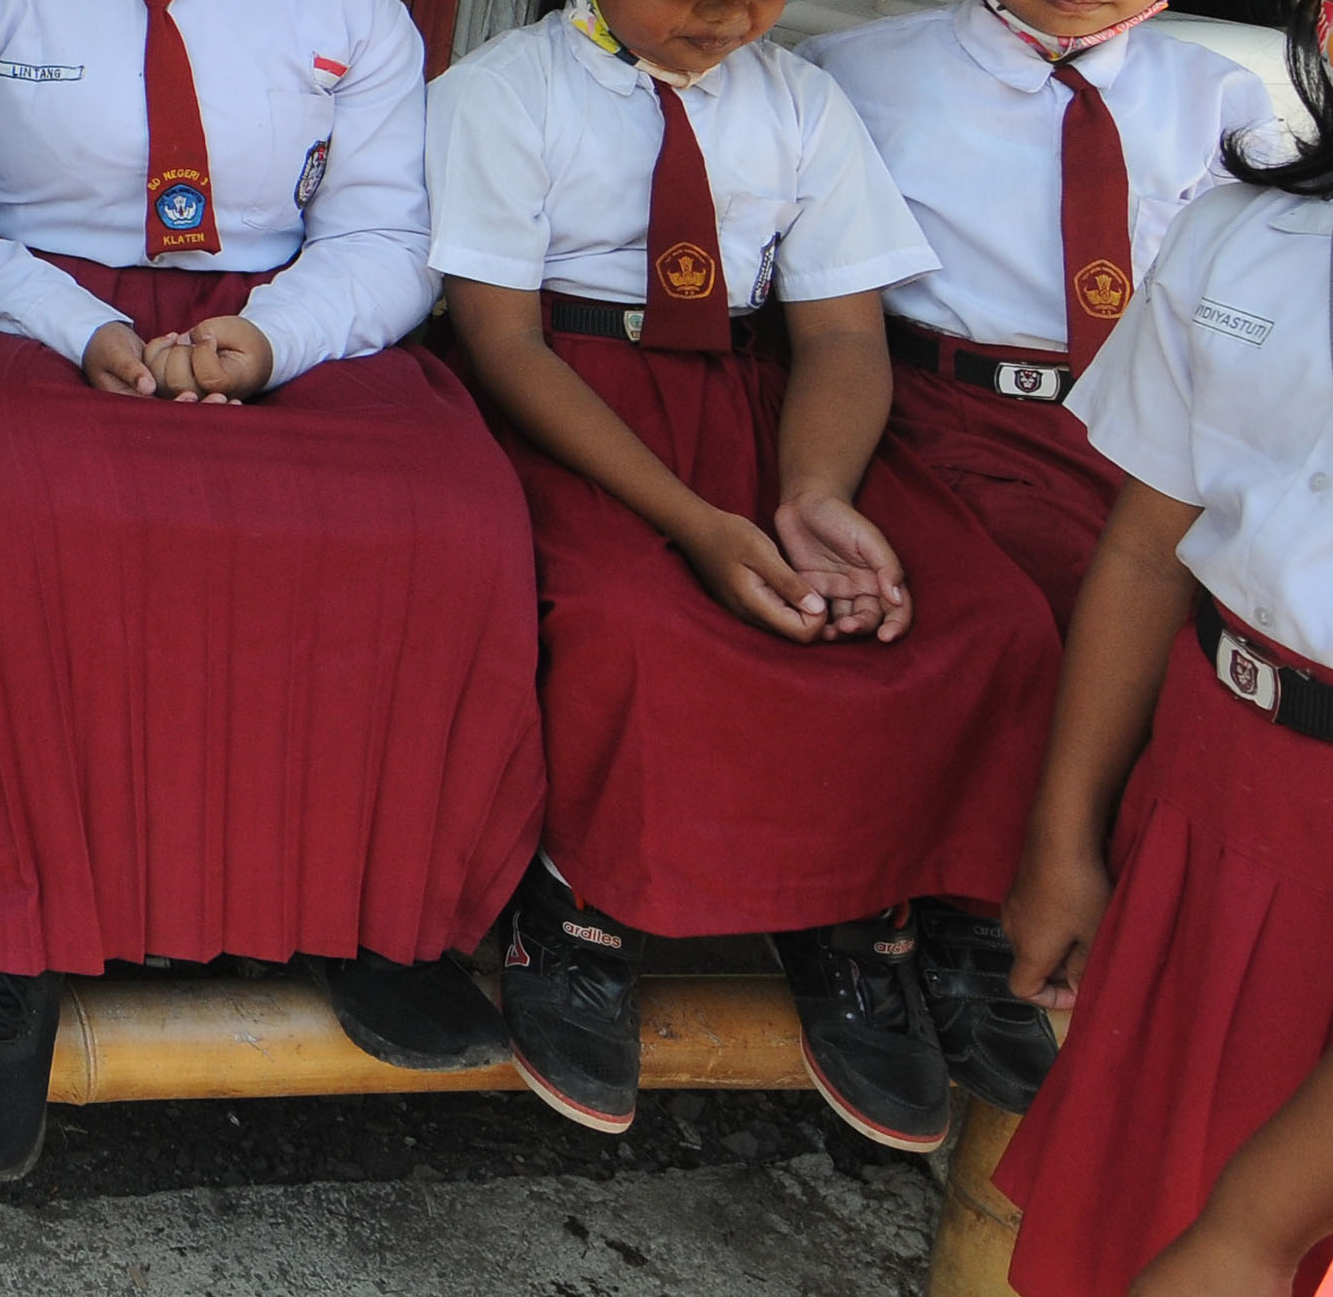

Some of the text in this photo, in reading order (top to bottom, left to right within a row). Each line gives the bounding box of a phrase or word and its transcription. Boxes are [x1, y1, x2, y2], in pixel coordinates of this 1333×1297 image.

[13, 66, 61, 79] LINTANG
[163, 169, 200, 181] NEGERI
[163, 232, 205, 246] KLATEN
